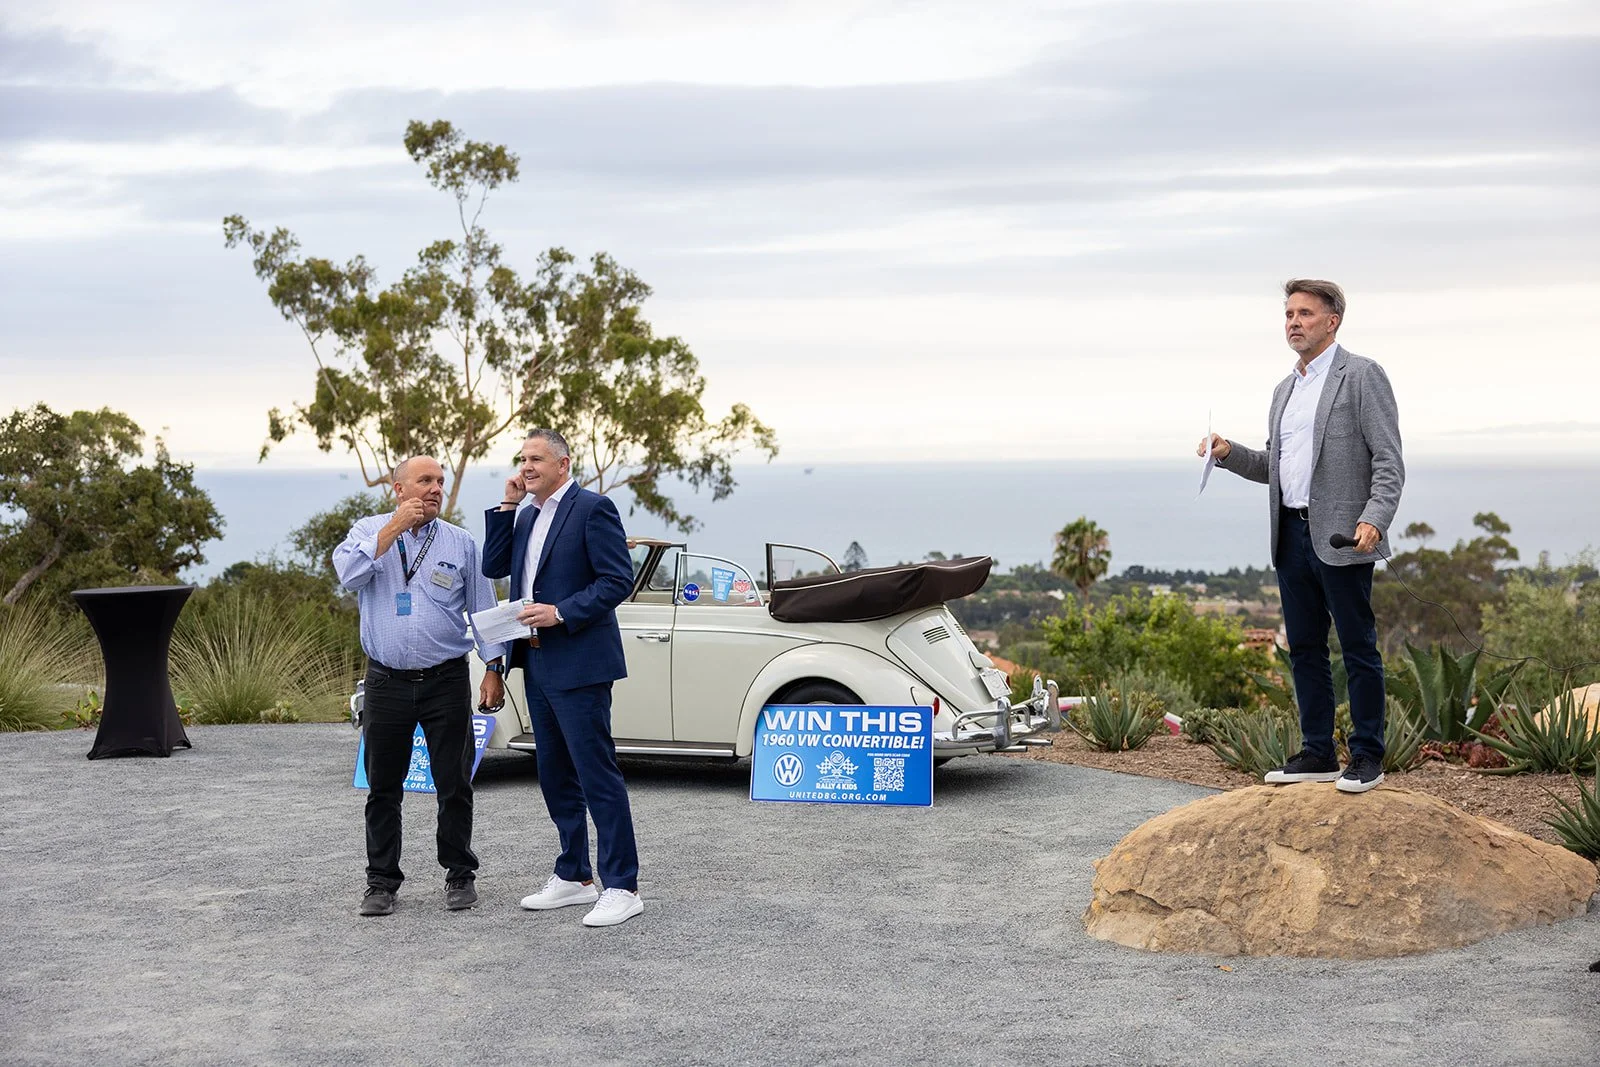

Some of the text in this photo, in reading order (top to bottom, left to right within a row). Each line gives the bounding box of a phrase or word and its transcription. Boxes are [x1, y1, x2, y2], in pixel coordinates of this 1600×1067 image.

[763, 710, 922, 733] WIN THIS
[762, 734, 926, 749] 1960 VW CONVERTIBLE!
[815, 782, 835, 790] RALLY
[842, 783, 858, 791] KIDS
